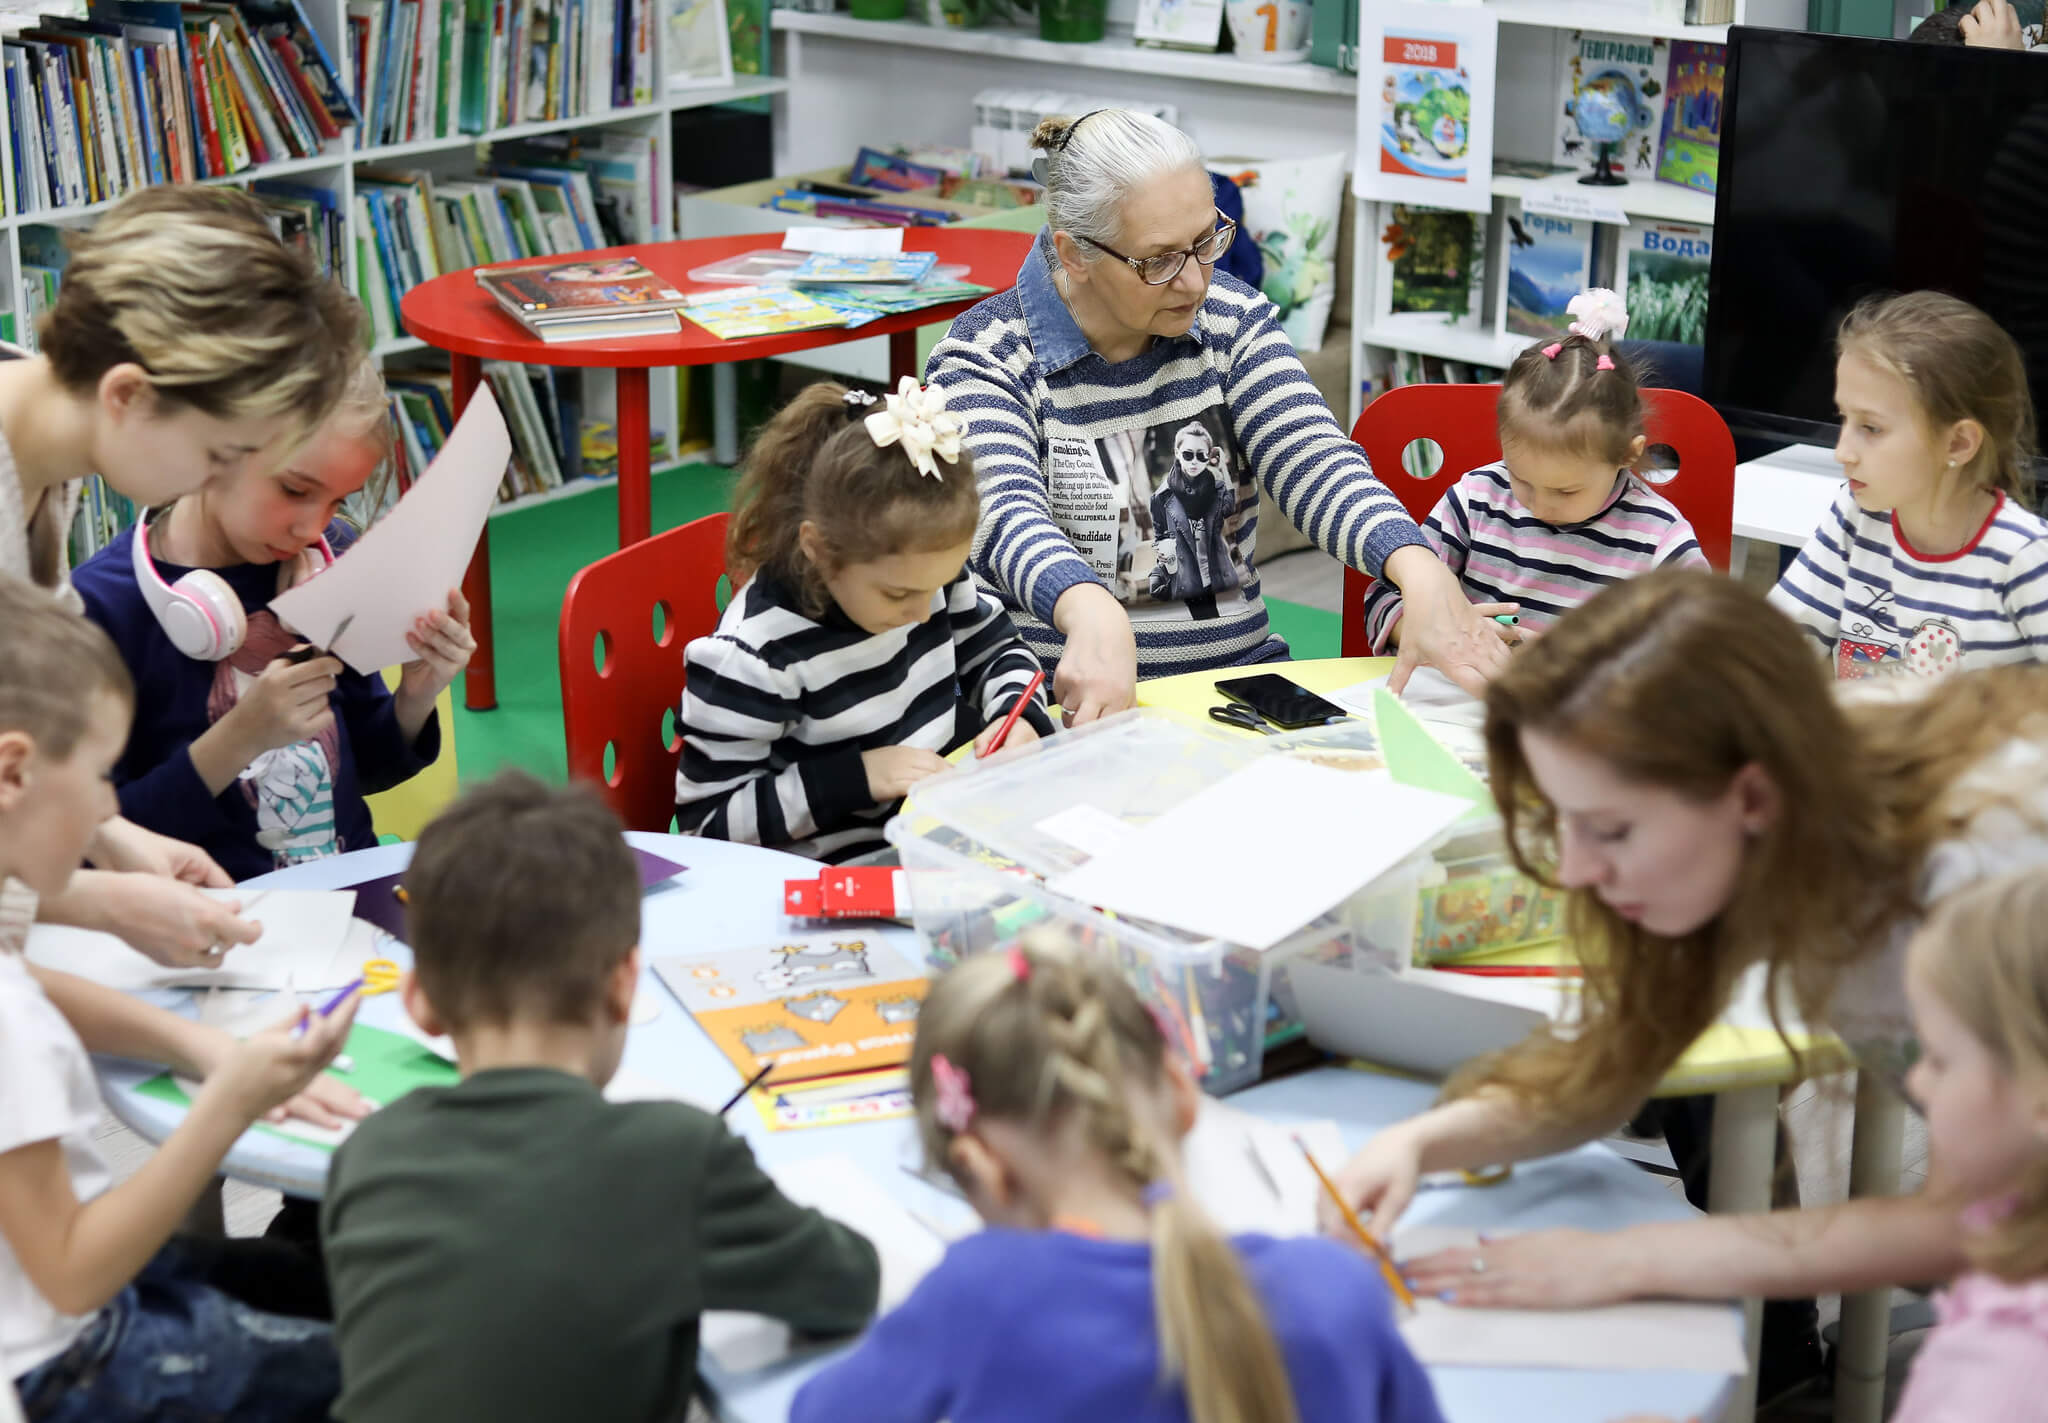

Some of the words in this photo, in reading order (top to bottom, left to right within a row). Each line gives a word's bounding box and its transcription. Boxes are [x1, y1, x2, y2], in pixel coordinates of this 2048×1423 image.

[1523, 211, 1573, 236] Горы
[1643, 231, 1711, 258] Вода
[1053, 444, 1082, 457] smoking
[1053, 458, 1065, 468] The
[1076, 483, 1085, 492] up
[1071, 491, 1083, 500] food
[1053, 502, 1074, 511] around
[1074, 502, 1094, 511] mobile
[1095, 502, 1108, 511] food
[1072, 530, 1112, 542] candidate
